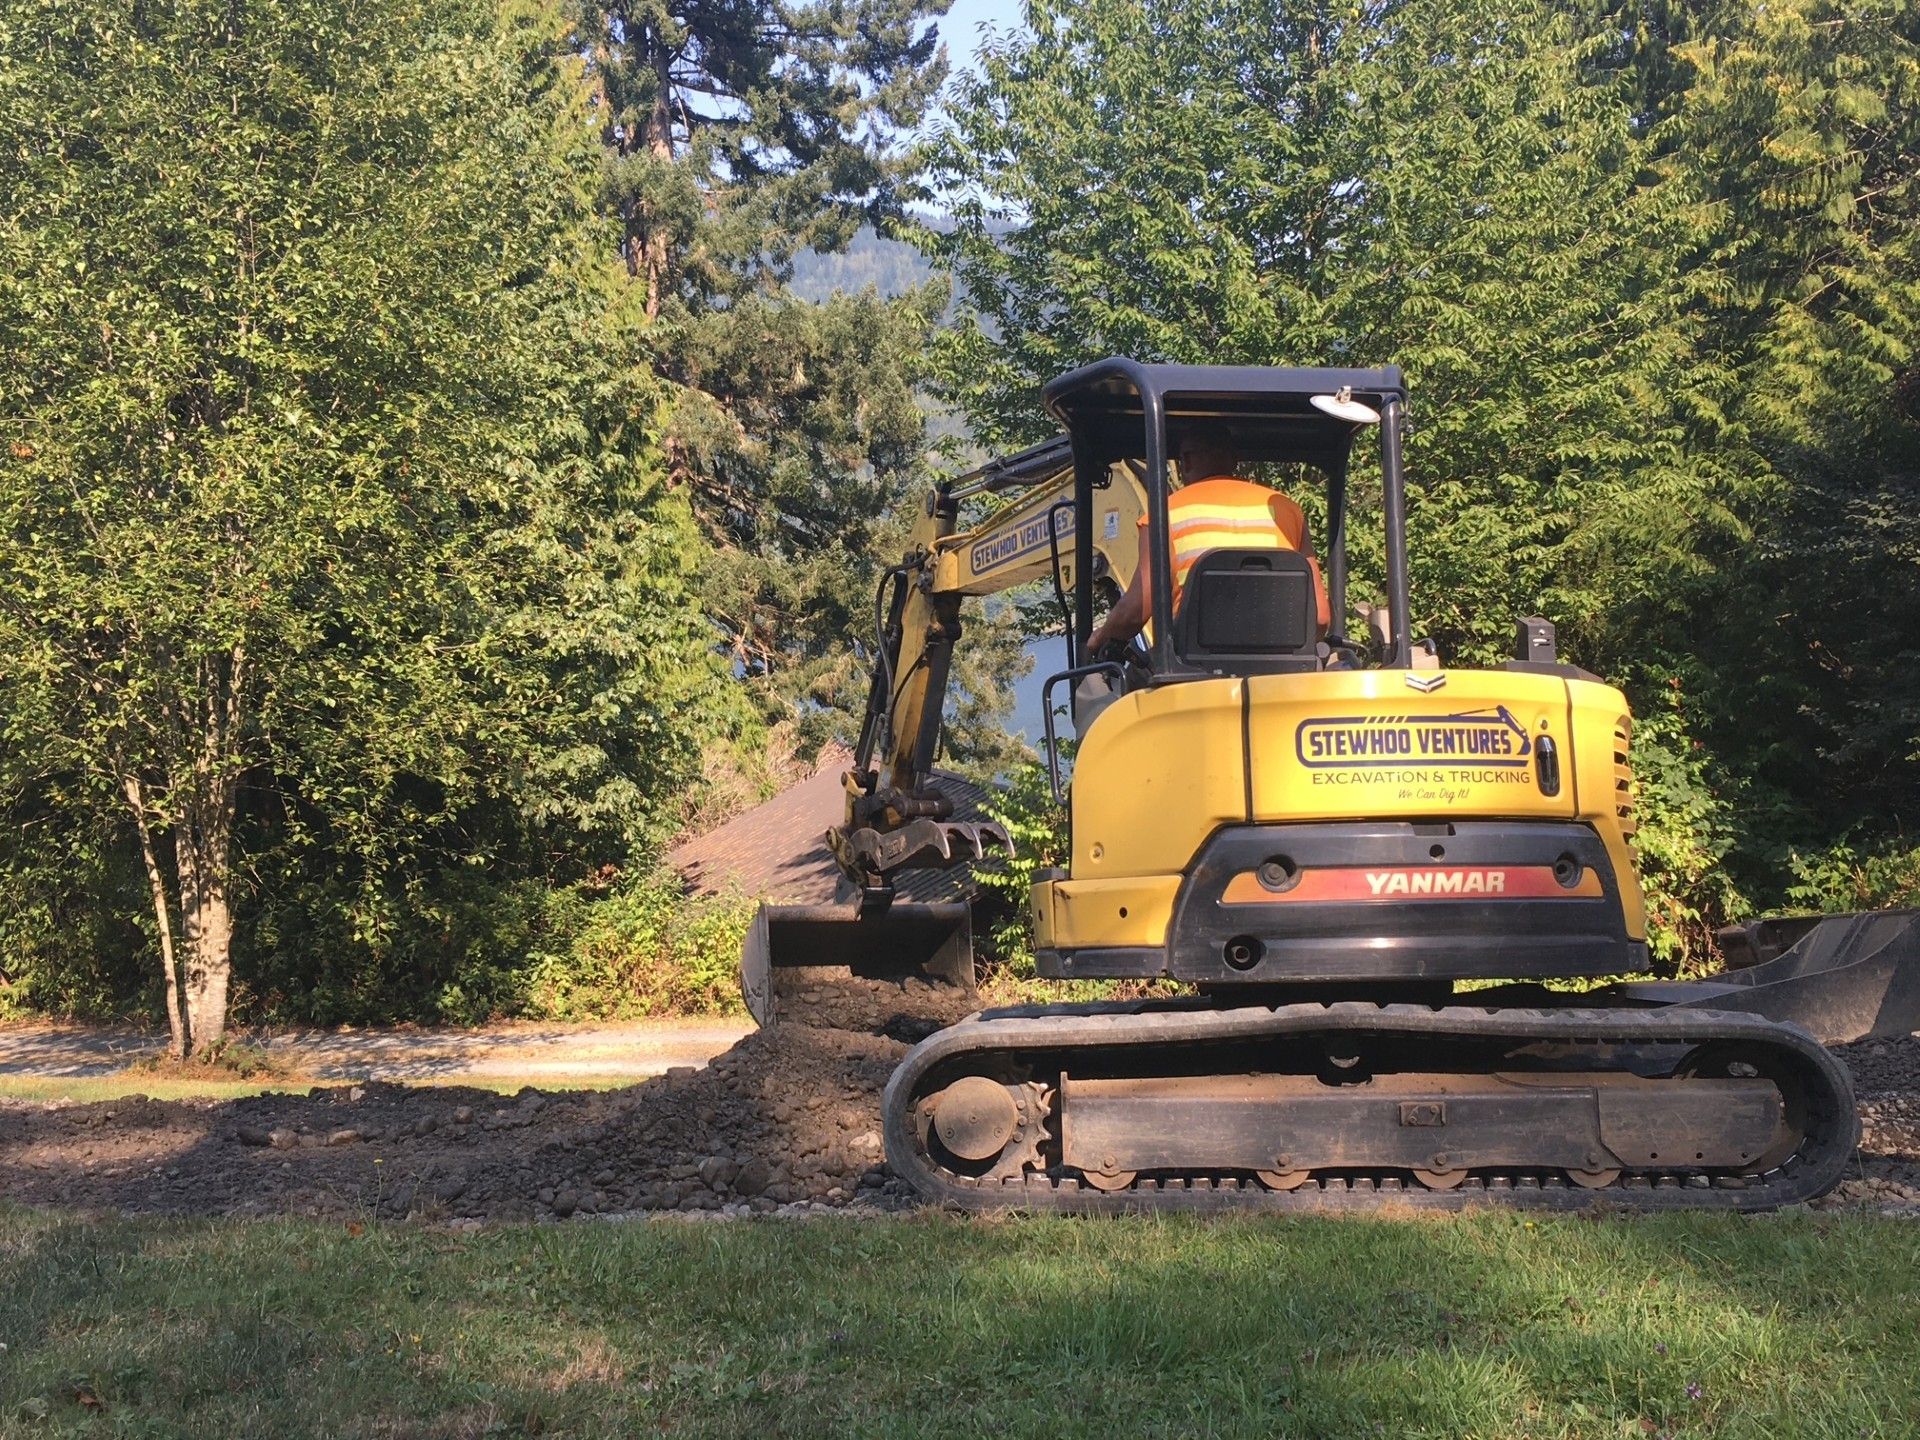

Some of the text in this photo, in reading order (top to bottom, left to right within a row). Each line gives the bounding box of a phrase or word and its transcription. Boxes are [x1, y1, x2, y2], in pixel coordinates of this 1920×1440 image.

[974, 509, 1069, 568] STEWHOO VENTUES
[1310, 729, 1511, 756] STEWHOO VENTURES
[1312, 770, 1530, 785] EXCAVATION & TRUCKING
[1398, 788, 1413, 799] We
[1416, 787, 1436, 799] Can
[1439, 787, 1455, 804] Dig
[1366, 871, 1505, 894] YANMAR
